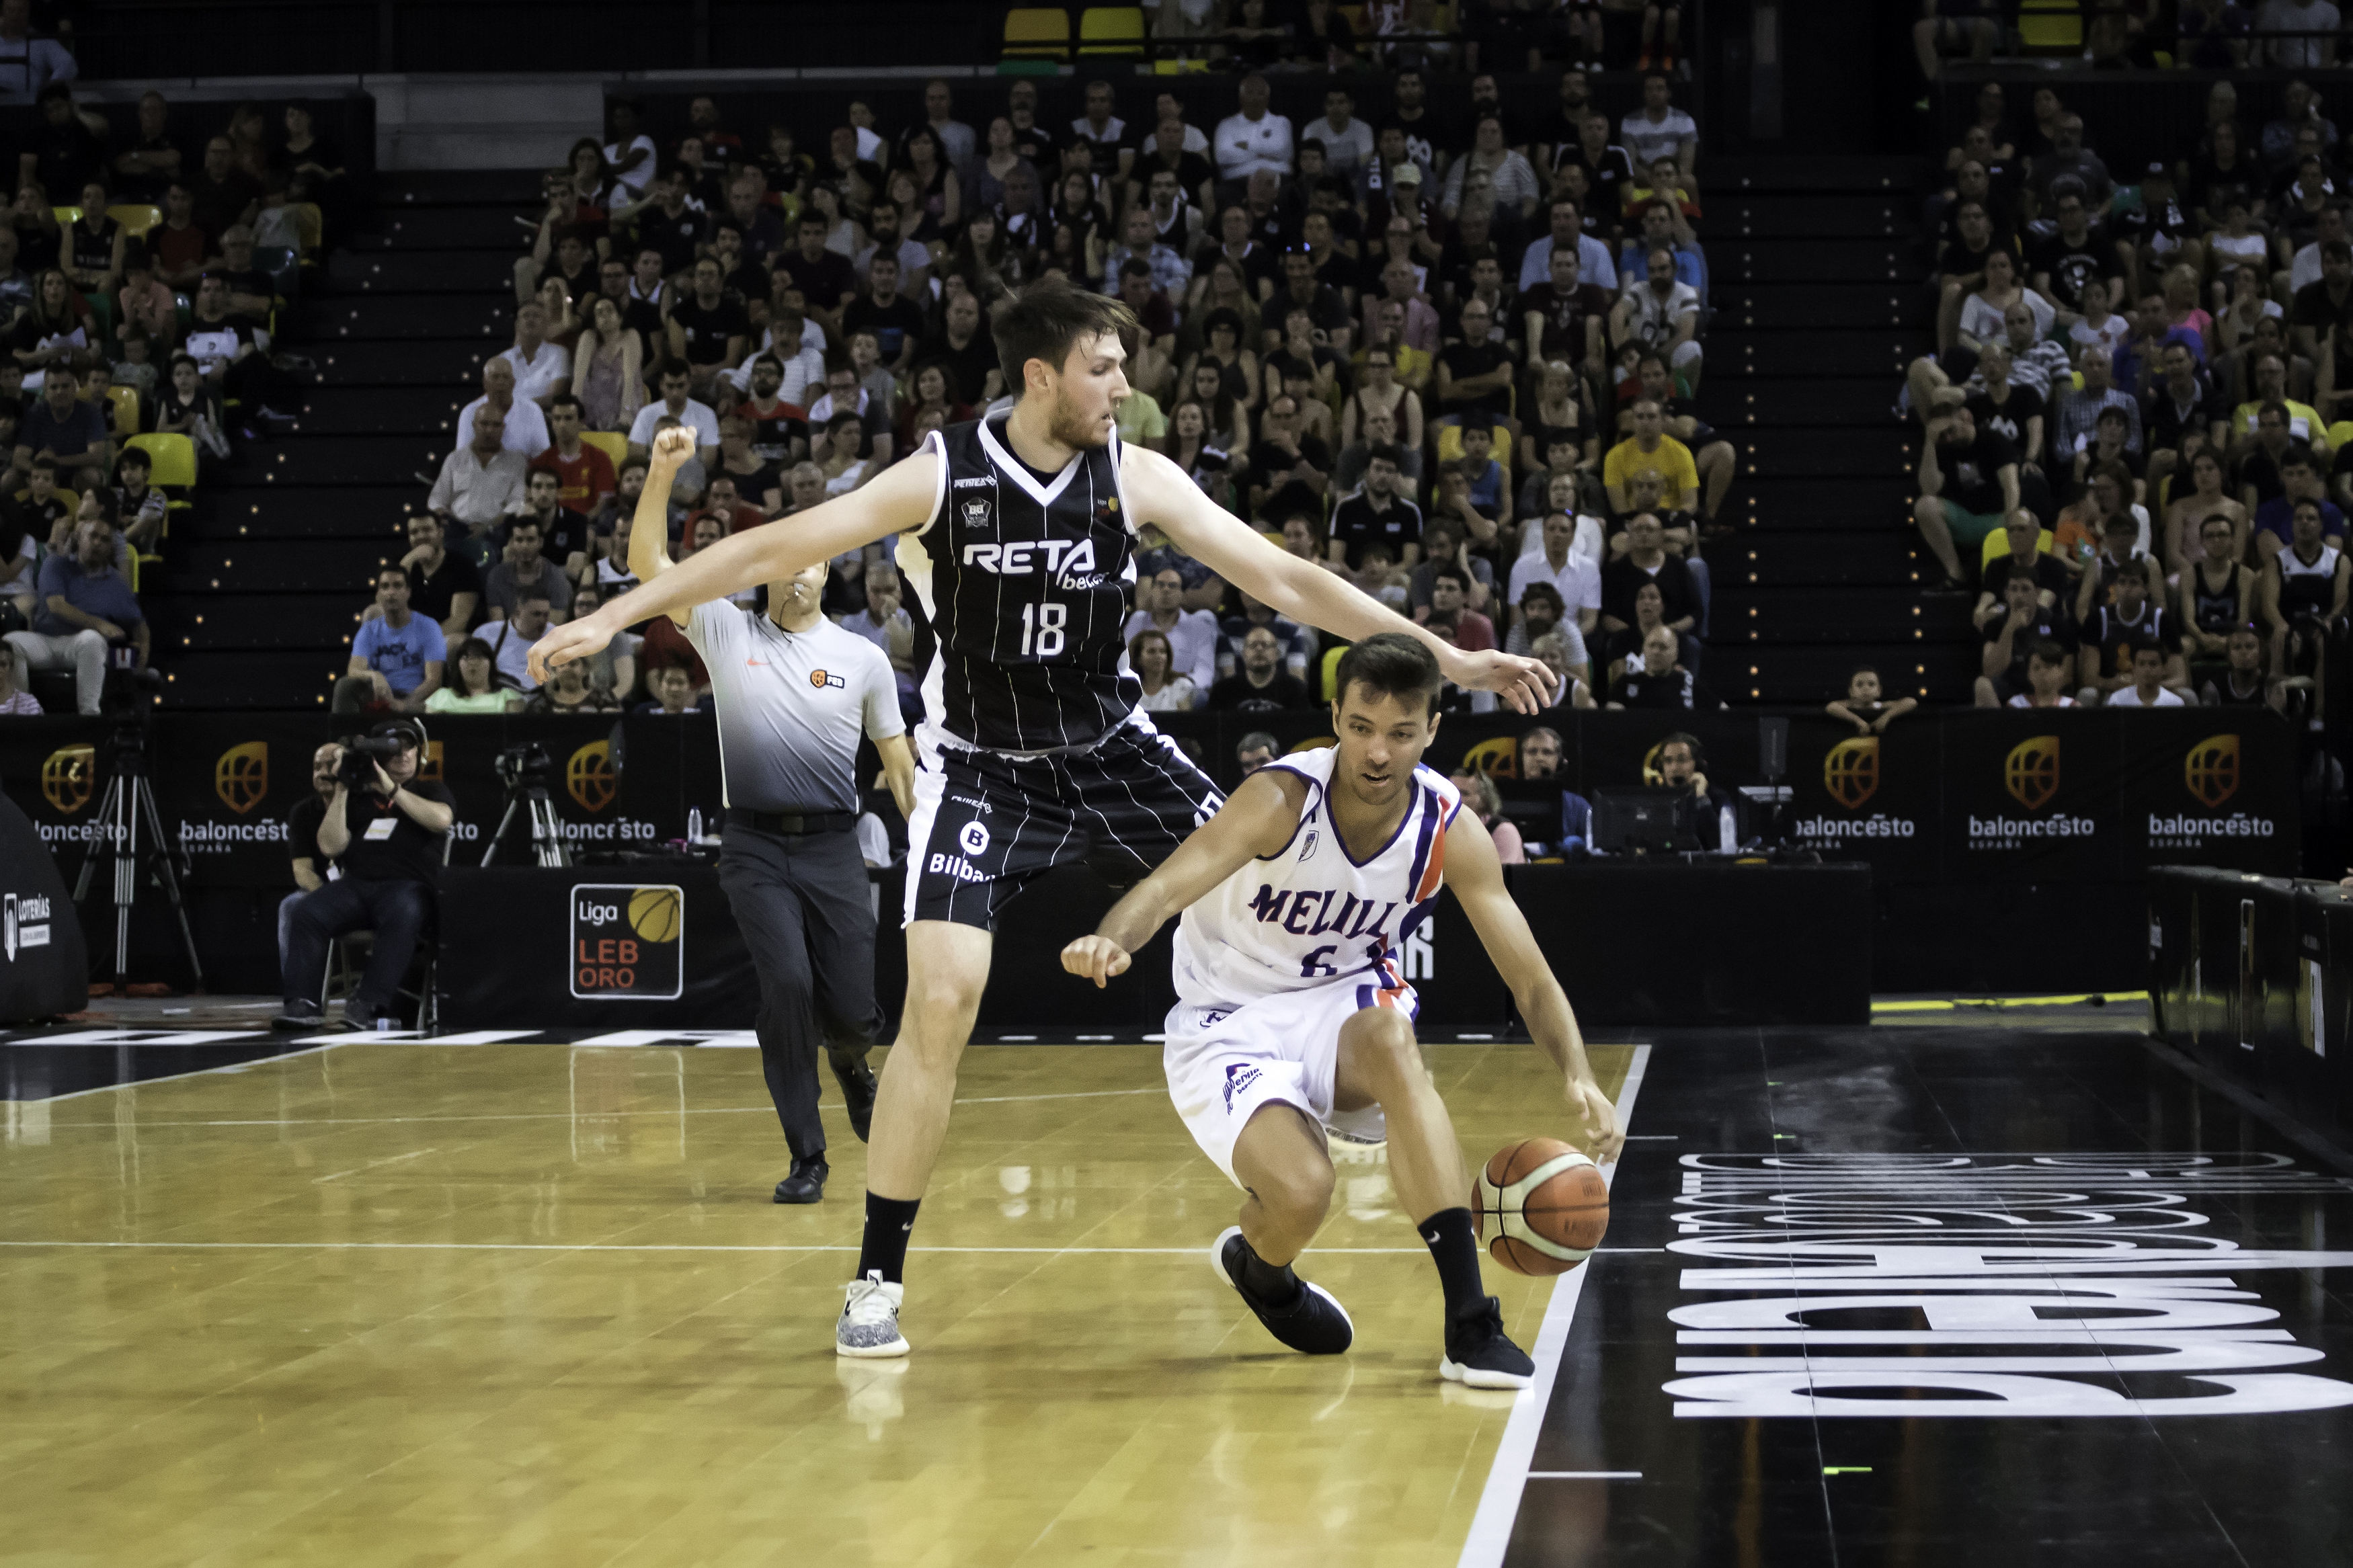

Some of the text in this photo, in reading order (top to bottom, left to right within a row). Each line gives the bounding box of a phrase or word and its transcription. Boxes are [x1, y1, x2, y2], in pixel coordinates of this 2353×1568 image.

[963, 538, 1095, 587] RETA
[1021, 602, 1067, 656] 18
[827, 675, 844, 688] FEB
[183, 842, 232, 853] SPAÑA
[967, 828, 984, 847] B
[579, 901, 618, 925] Liga
[579, 940, 638, 964] LEB
[579, 968, 635, 988] ORO
[1661, 1248, 2353, 1417] Arena
